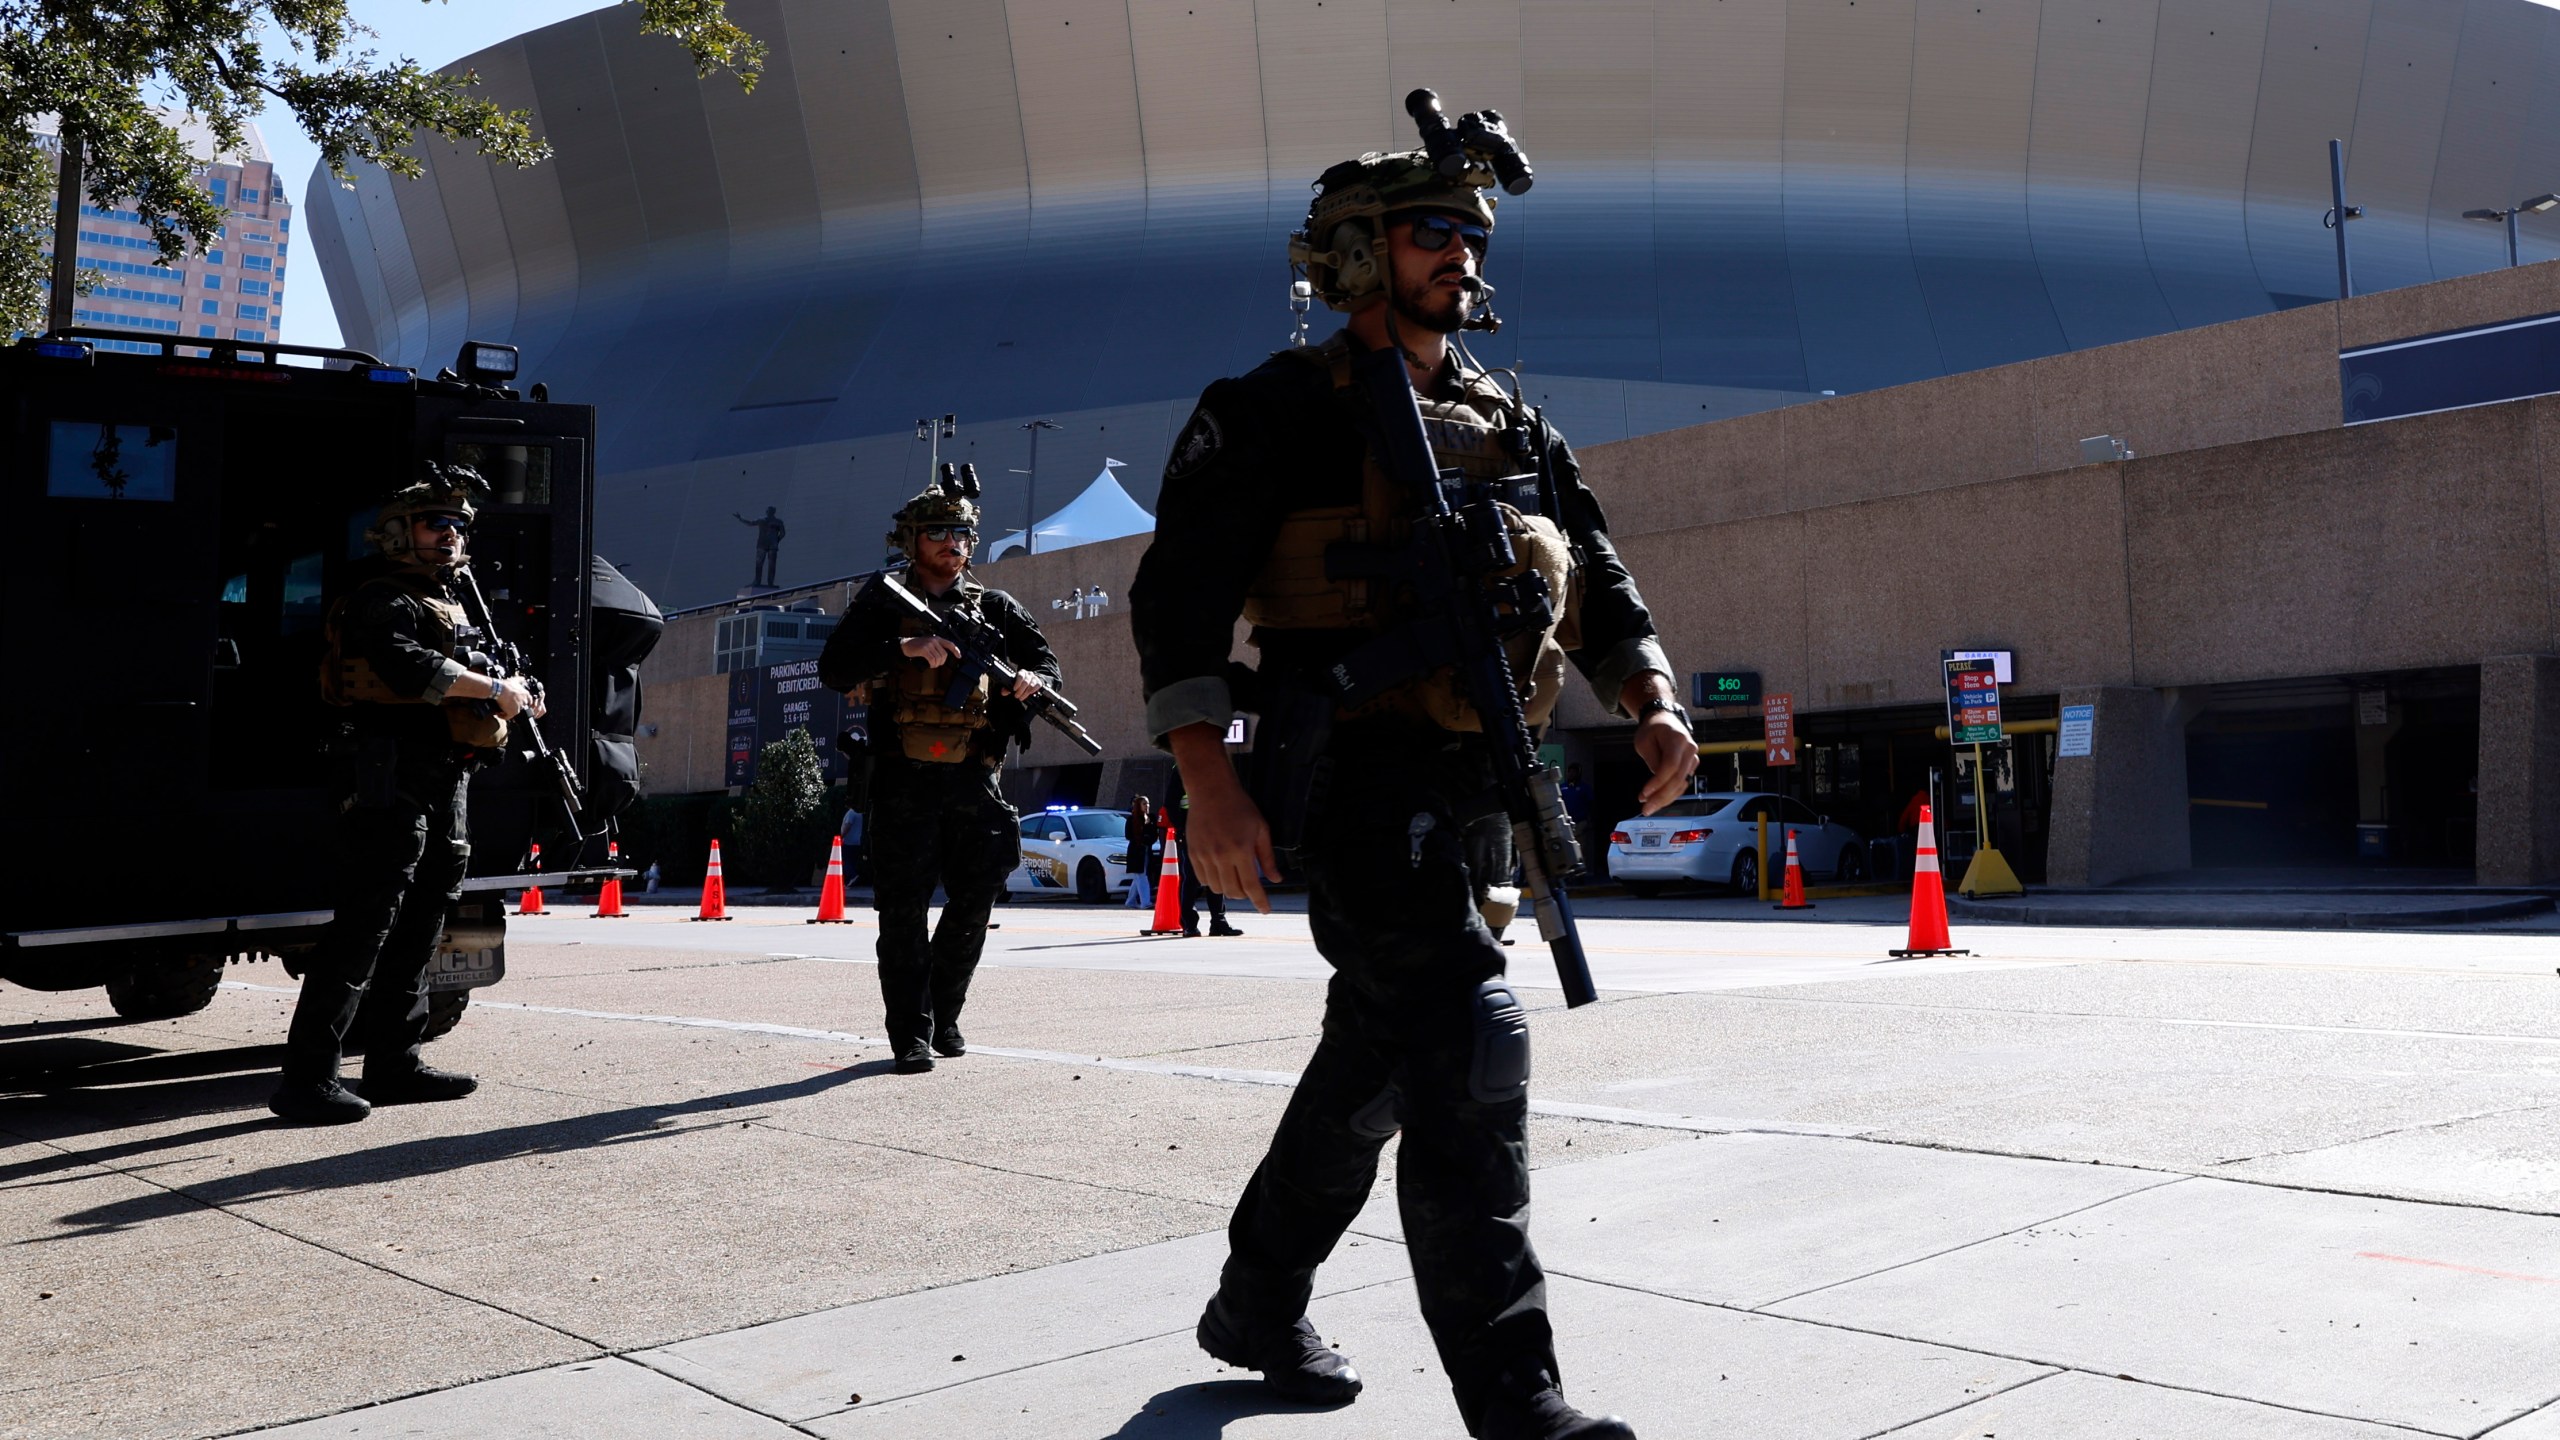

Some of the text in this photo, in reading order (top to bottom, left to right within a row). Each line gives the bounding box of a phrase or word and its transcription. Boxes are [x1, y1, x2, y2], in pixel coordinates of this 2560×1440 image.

[770, 660, 819, 679] PARKING PASS
[1718, 677, 1740, 691] $60
[1768, 706, 1786, 714] LANES
[2064, 709, 2091, 719] NOTICE
